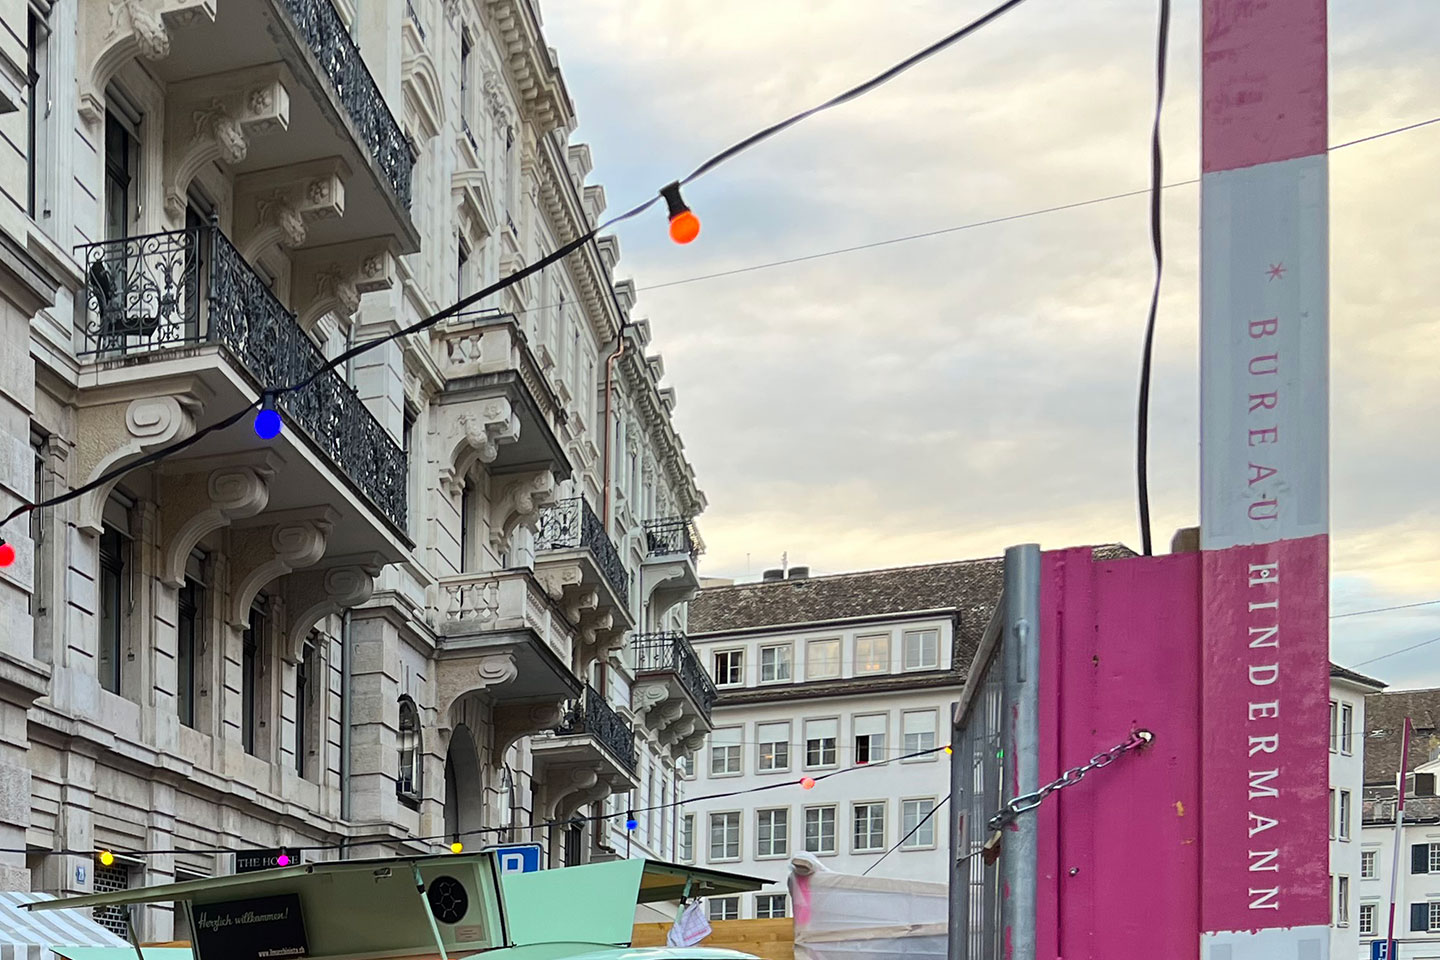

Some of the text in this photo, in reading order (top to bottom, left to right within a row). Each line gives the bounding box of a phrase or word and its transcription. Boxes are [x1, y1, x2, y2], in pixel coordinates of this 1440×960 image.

[1247, 315, 1280, 911] BUREAU HINDERMANN
[237, 855, 299, 868] THE HOSE
[501, 853, 525, 876] P
[197, 911, 233, 932] Herzlich
